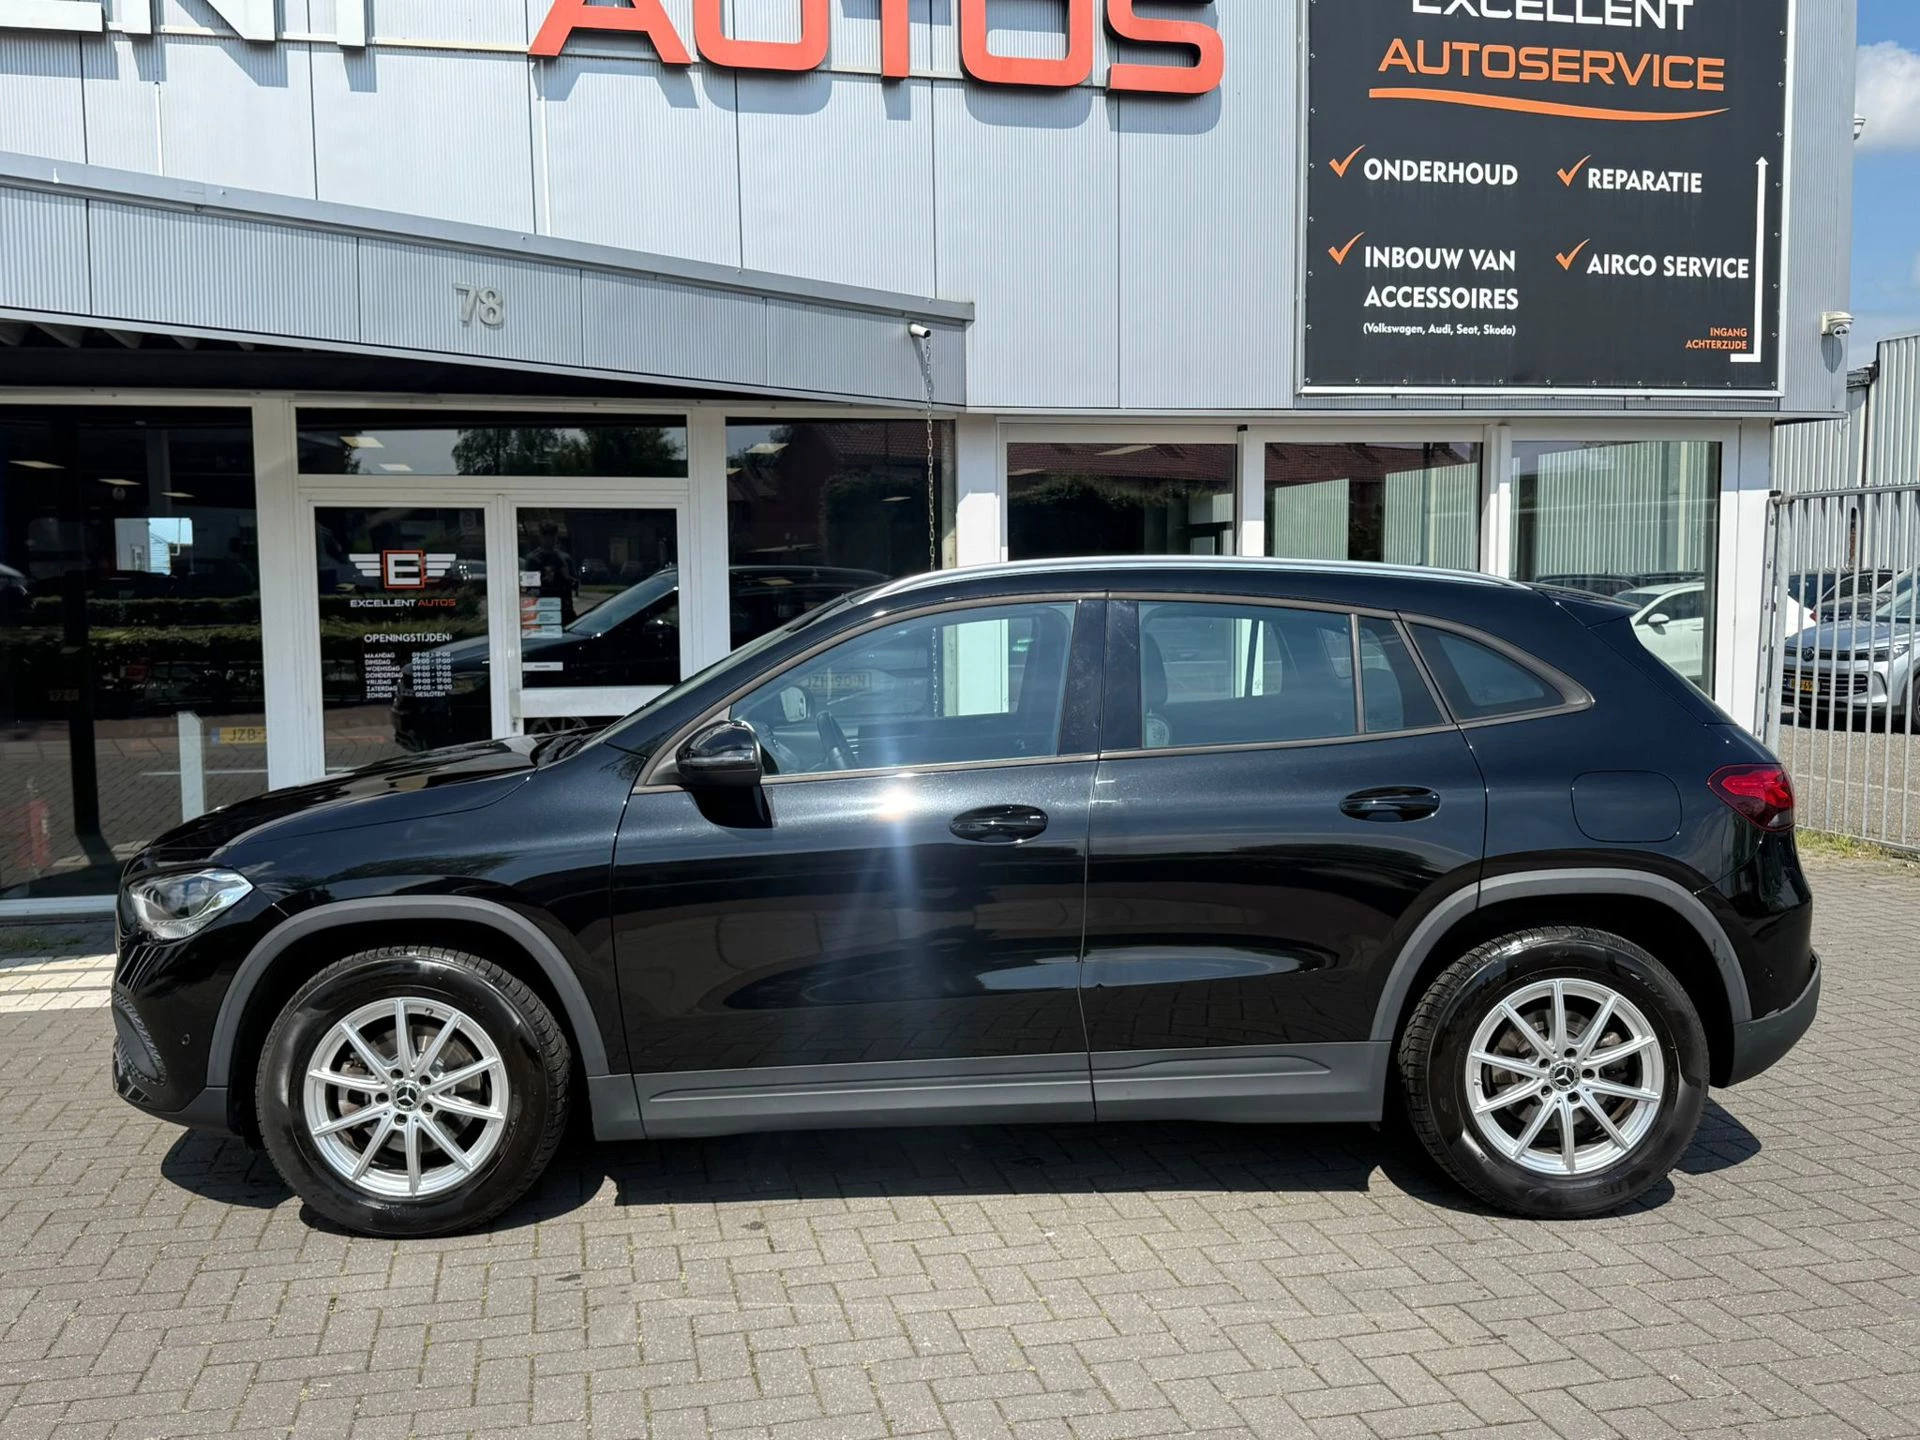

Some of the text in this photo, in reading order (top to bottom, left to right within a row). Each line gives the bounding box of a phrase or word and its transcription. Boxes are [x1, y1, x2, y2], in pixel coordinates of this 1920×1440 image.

[528, 0, 1224, 94] AUTOS
[1378, 38, 1725, 92] AUTOSERVICE
[1363, 157, 1519, 187] ONDERHOUD
[1587, 167, 1703, 194] REPARATIE
[1364, 246, 1516, 272] INBOUW VAN
[1586, 253, 1750, 279] AIRCO SERVICE
[452, 282, 503, 326] 78
[1363, 285, 1519, 311] ACCESSOIRES
[1363, 322, 1516, 337] (Volkswagen, Audi, Seat, Skoda)
[1710, 327, 1748, 338] INGANG
[1685, 339, 1748, 350] ACHTERZIJDE
[387, 553, 420, 585] E
[350, 599, 456, 608] EXCELLENT AUTOS
